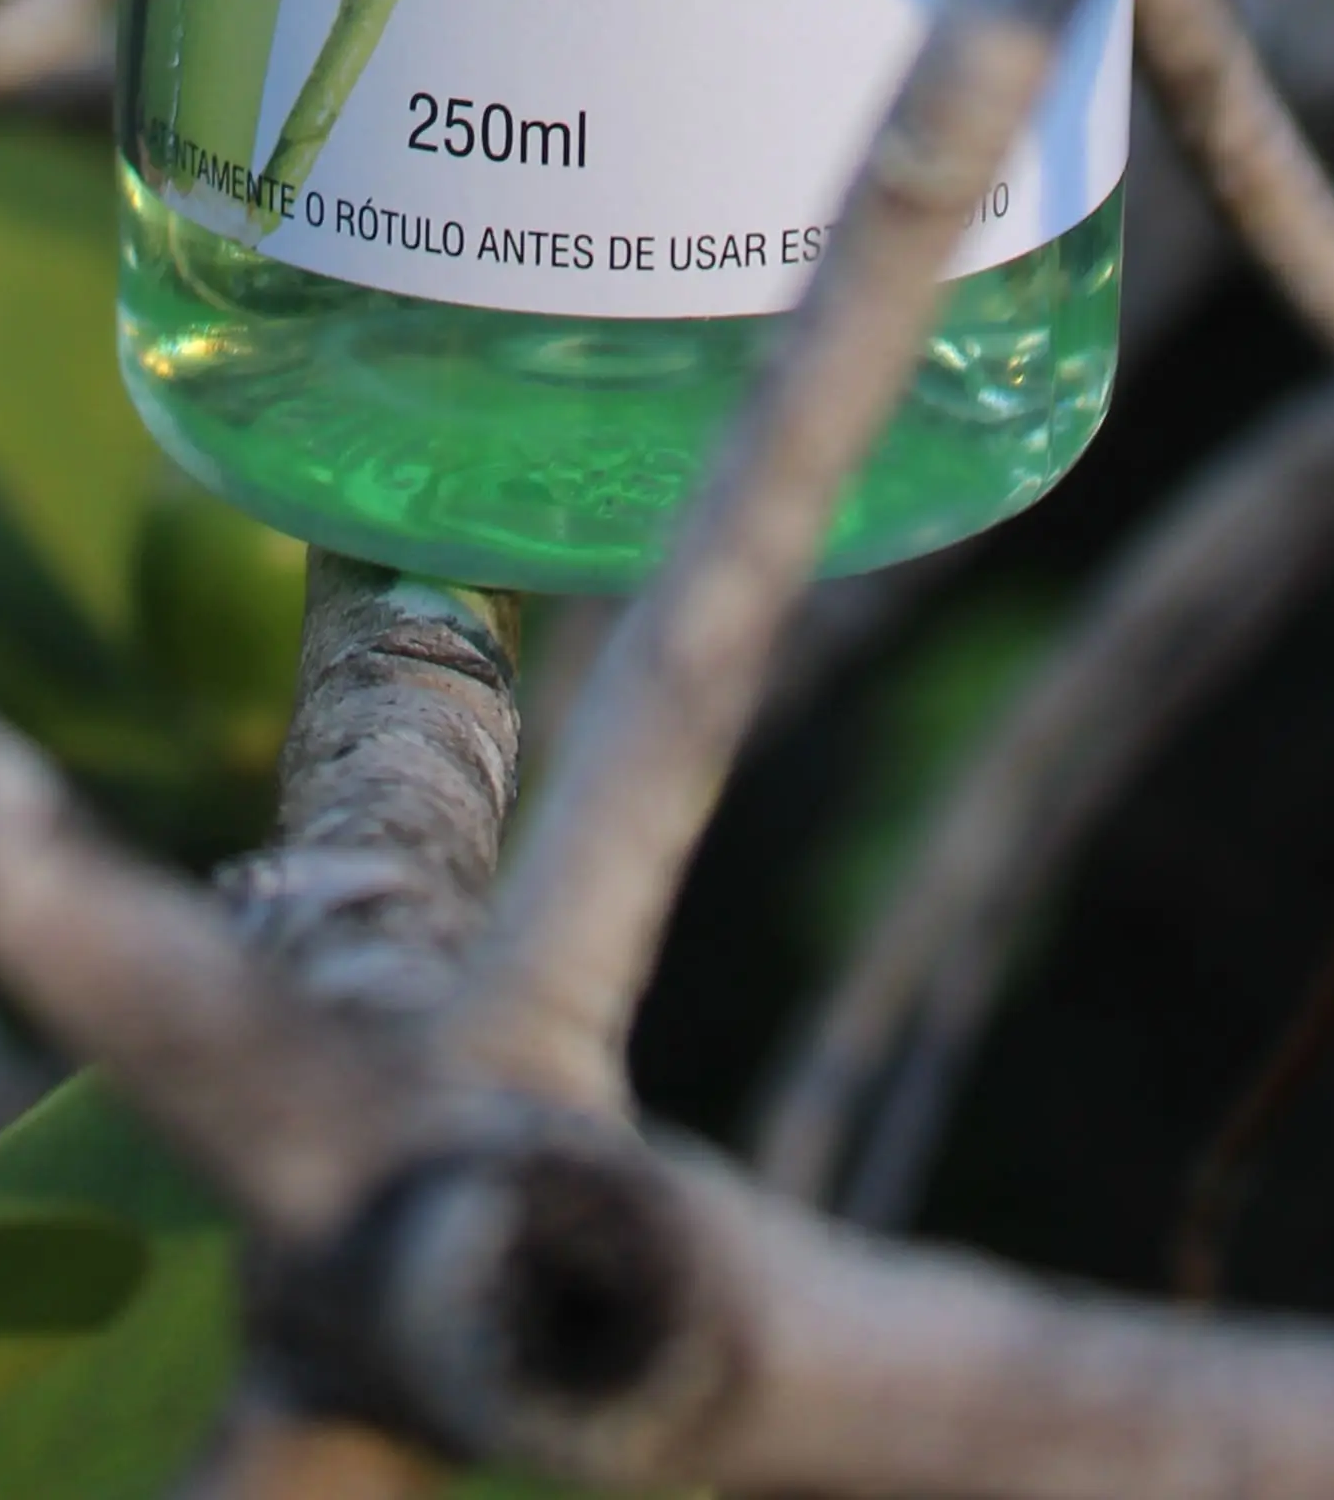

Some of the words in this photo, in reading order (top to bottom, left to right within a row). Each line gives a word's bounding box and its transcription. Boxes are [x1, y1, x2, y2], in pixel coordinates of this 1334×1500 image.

[407, 91, 588, 169] 250ml
[305, 190, 325, 228] O
[335, 196, 465, 258] RÓTULO
[476, 226, 595, 270] ANTES
[608, 236, 656, 271] DE
[670, 232, 767, 271] USAR
